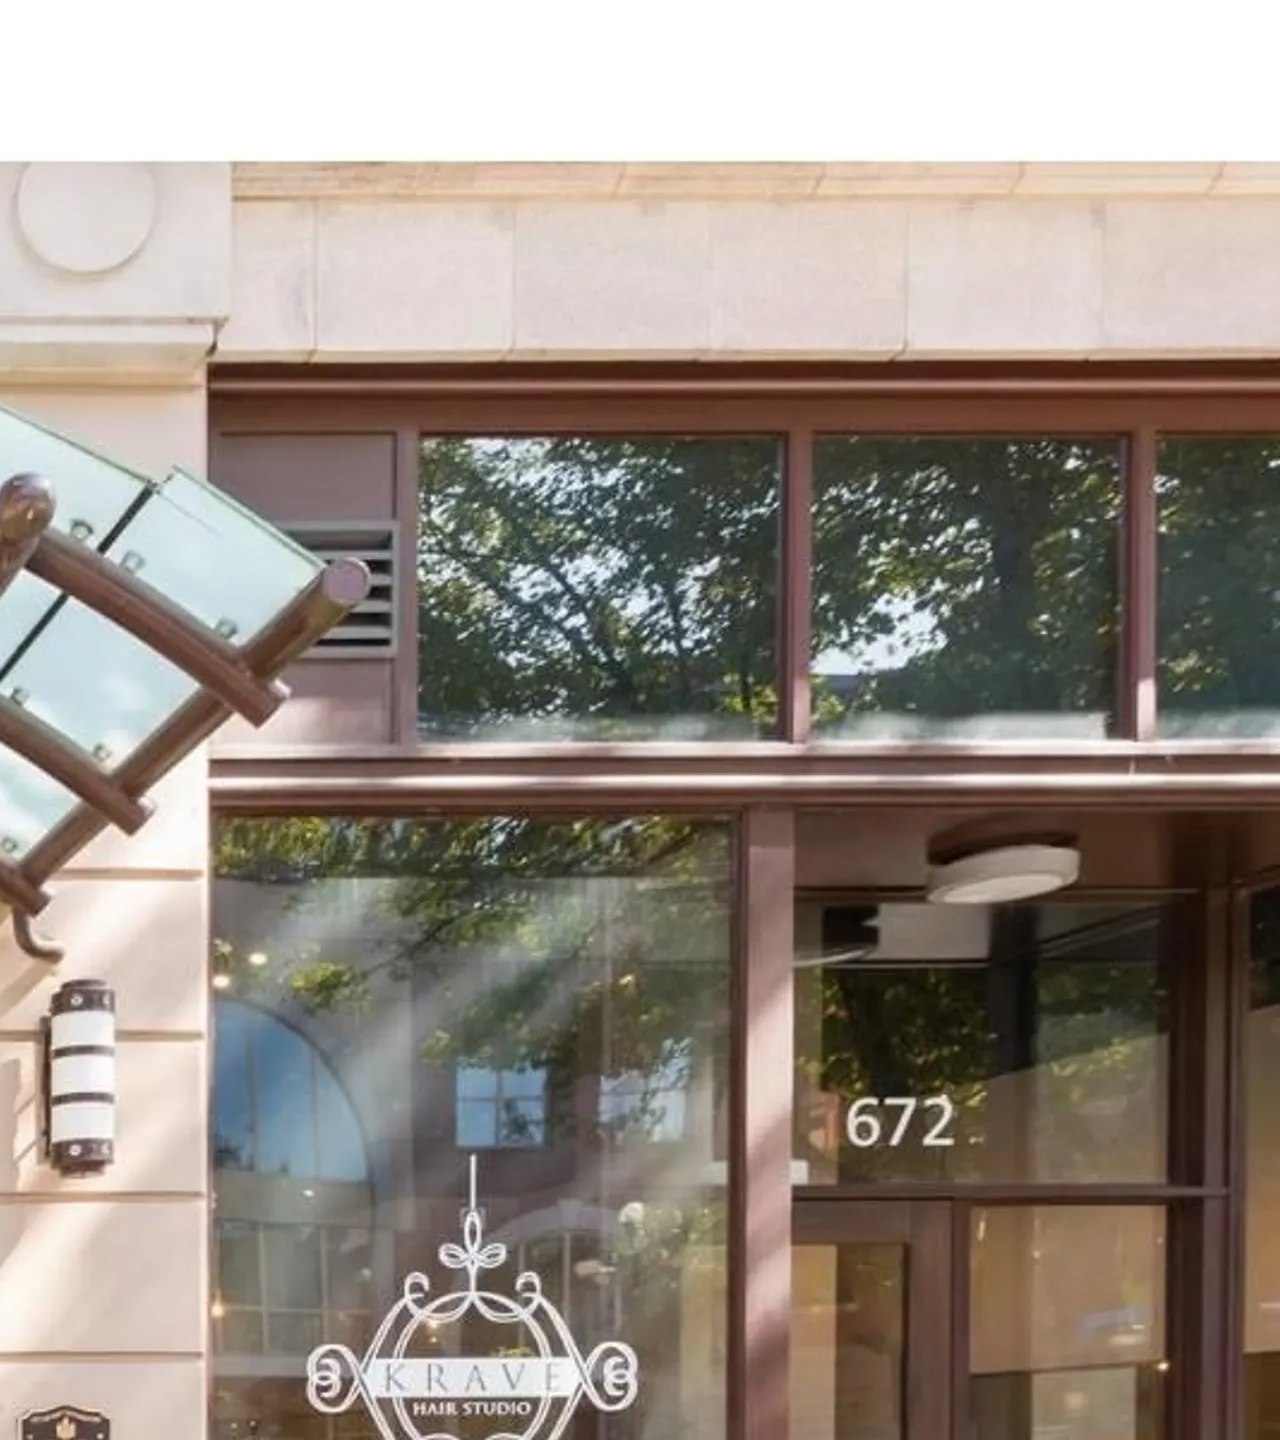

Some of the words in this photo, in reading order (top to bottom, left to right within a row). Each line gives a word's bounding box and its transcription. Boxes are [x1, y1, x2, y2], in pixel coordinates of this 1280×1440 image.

[846, 1095, 955, 1148] 672
[384, 1363, 563, 1393] KRAVE
[413, 1402, 459, 1417] HAIR
[462, 1402, 533, 1417] STUDIO
